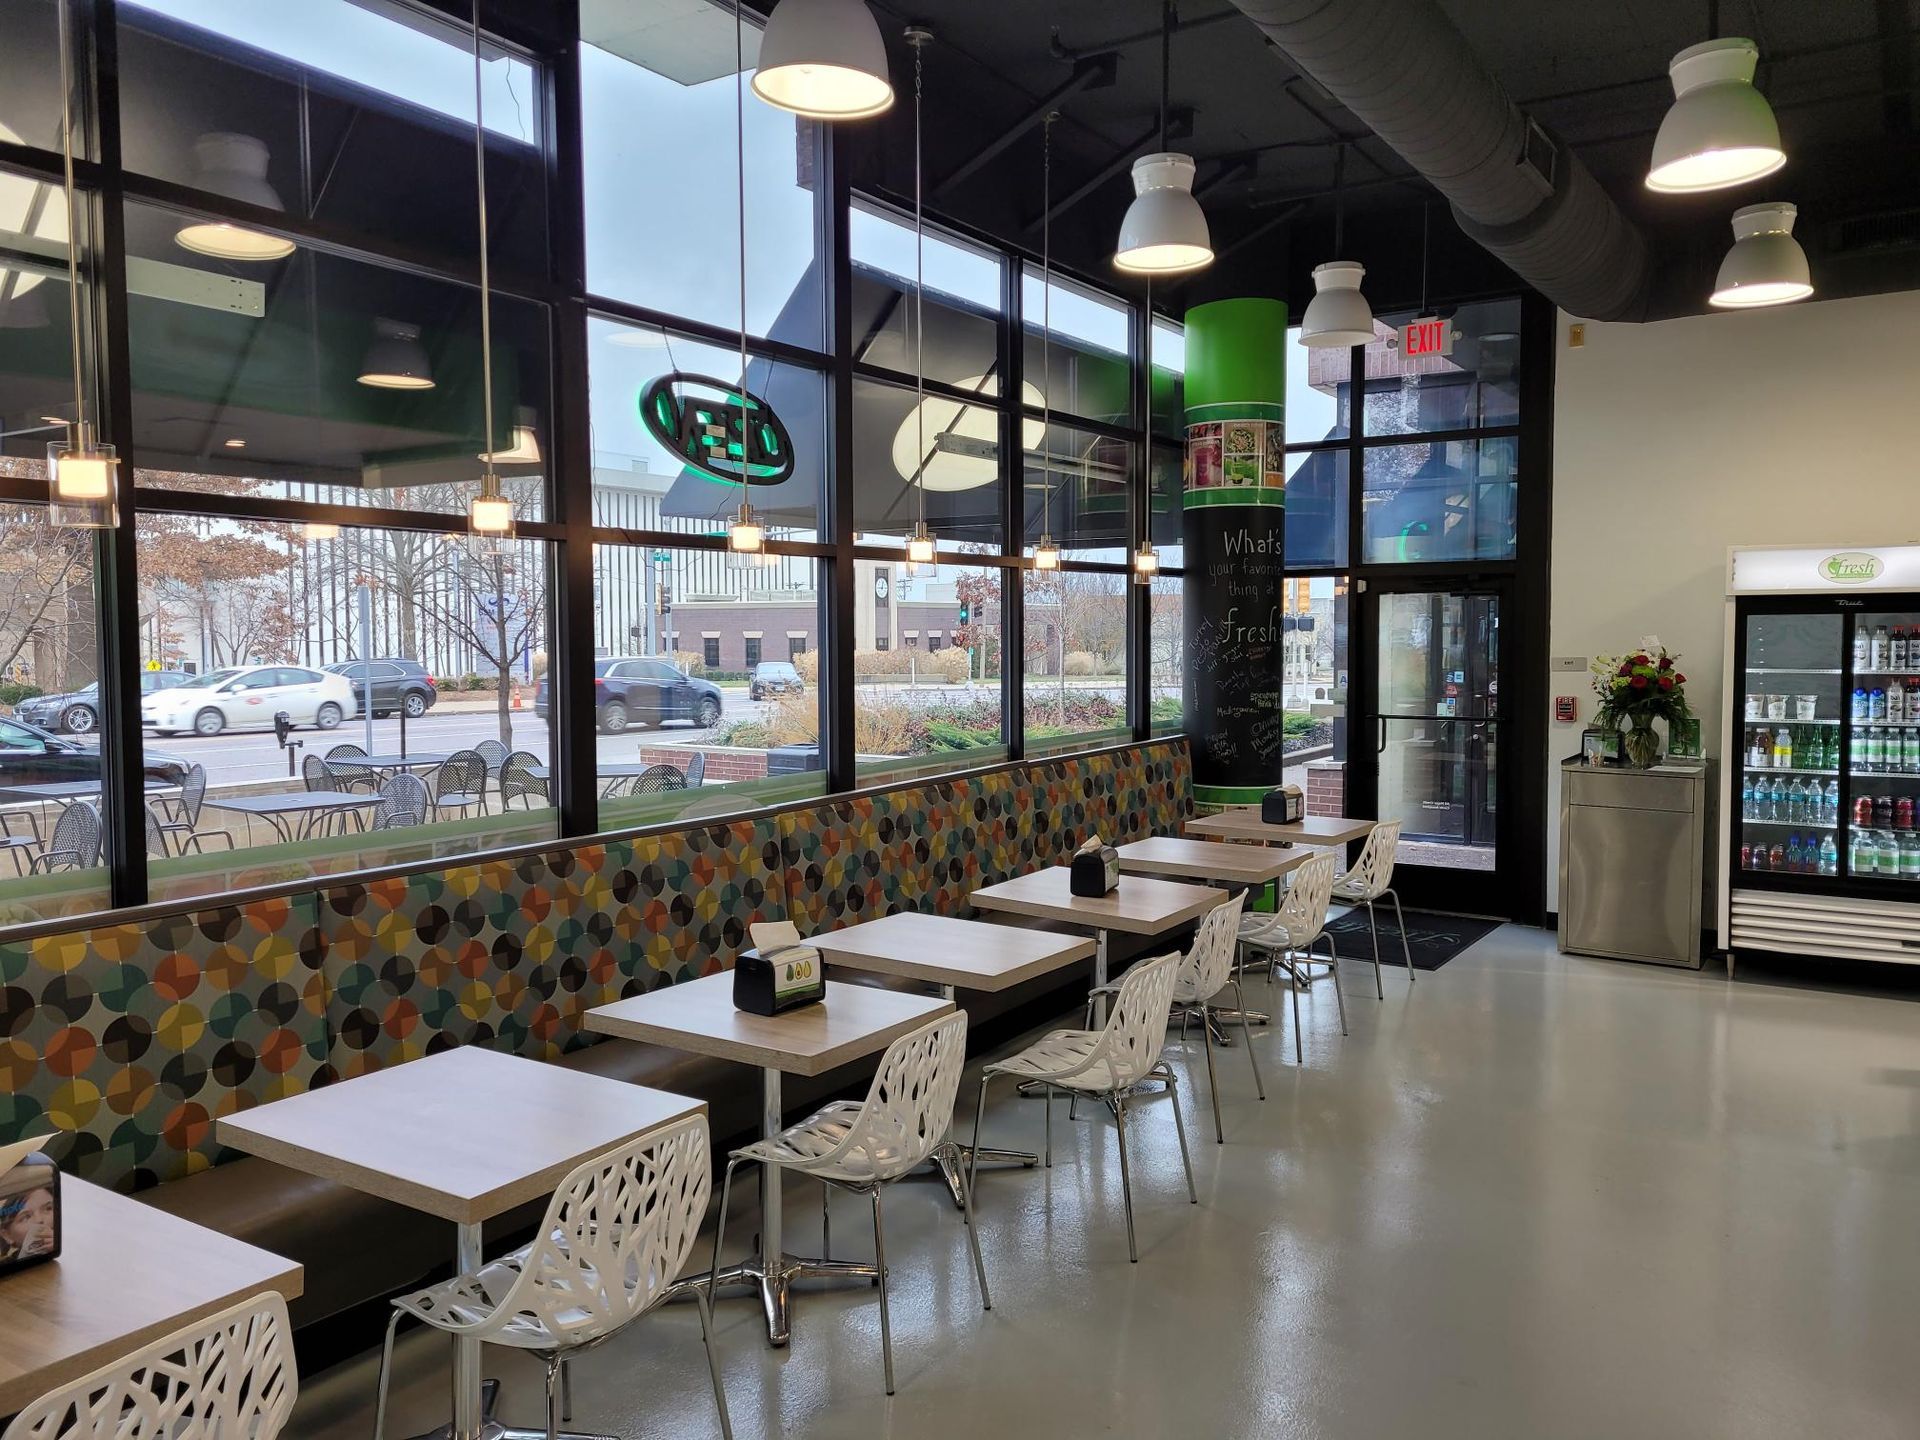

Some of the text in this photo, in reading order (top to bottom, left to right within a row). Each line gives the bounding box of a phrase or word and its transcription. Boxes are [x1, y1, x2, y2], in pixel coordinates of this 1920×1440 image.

[1406, 321, 1445, 355] EXIT
[1223, 528, 1282, 557] What's
[1209, 562, 1238, 586] your
[1837, 558, 1876, 577] fresh
[1228, 580, 1275, 603] thing at
